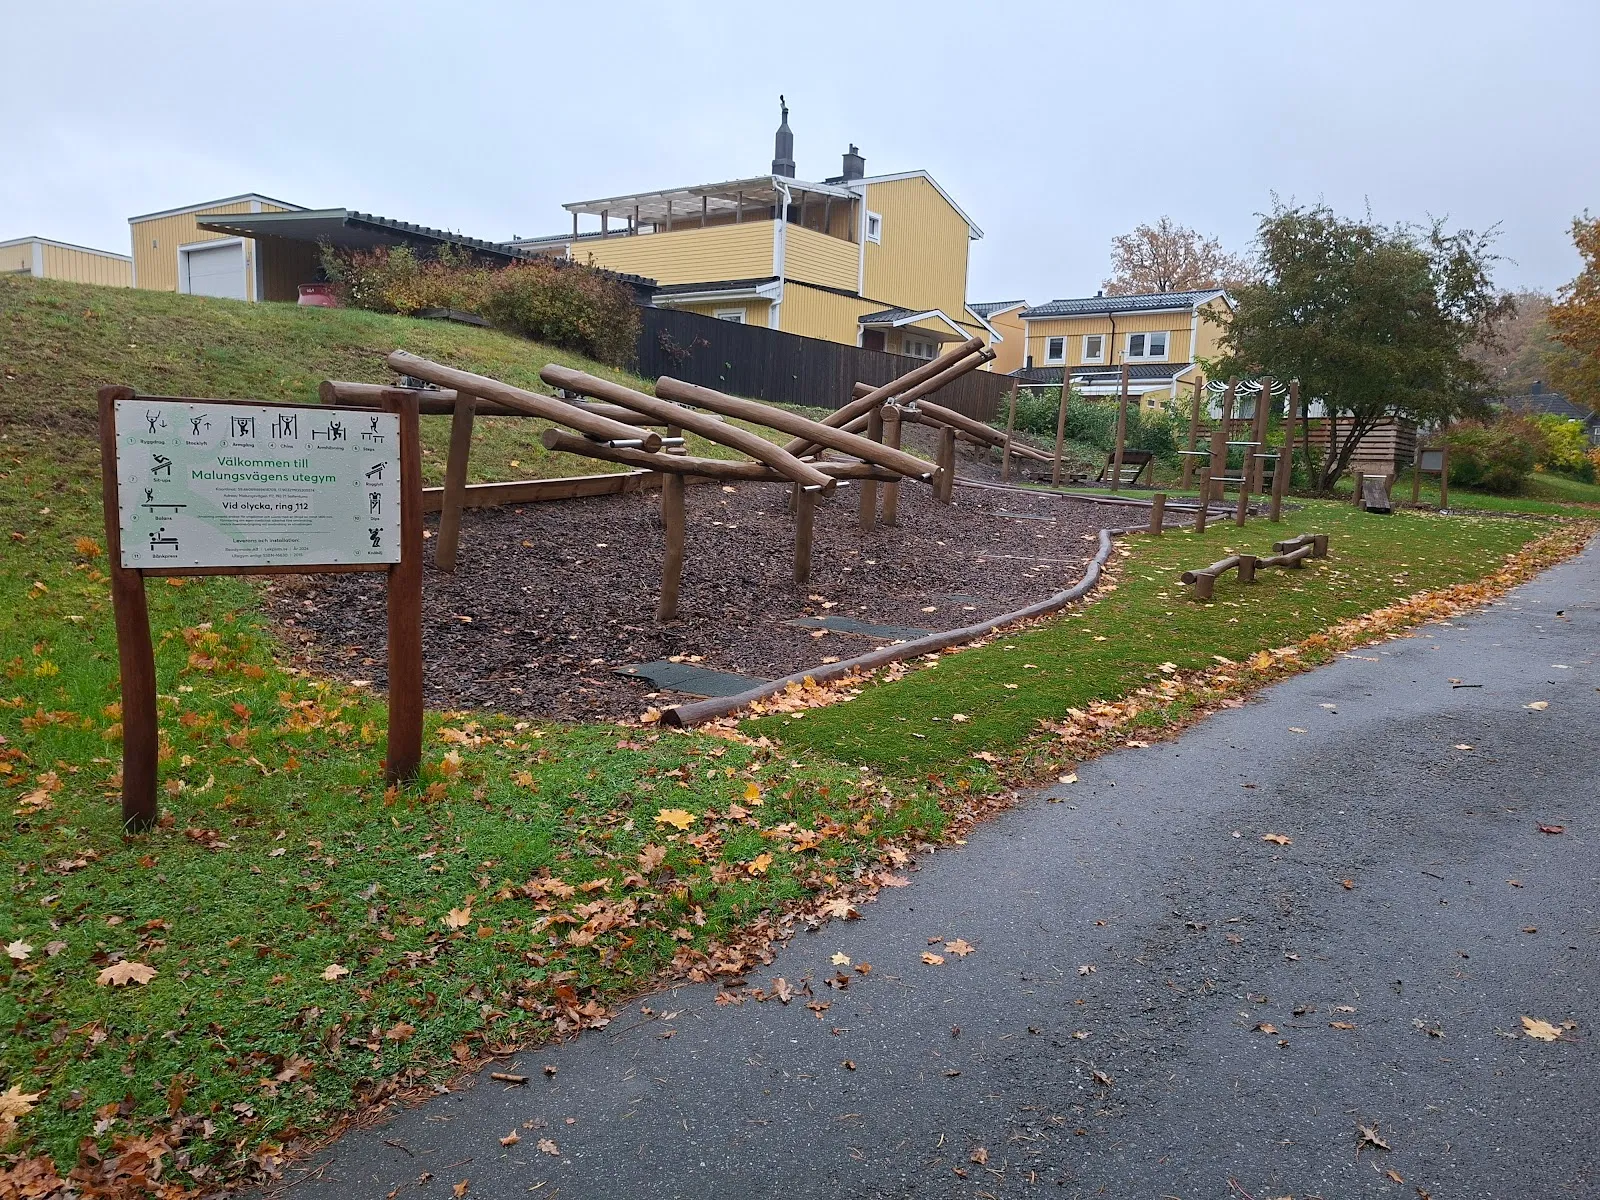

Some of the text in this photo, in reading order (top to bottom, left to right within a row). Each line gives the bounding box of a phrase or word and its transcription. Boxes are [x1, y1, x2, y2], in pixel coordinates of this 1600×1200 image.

[217, 456, 308, 468] Välkommen till
[192, 470, 336, 484] Malungsvägens utegym
[222, 502, 238, 510] Vid
[240, 502, 272, 511] olycka,
[276, 503, 293, 511] ring
